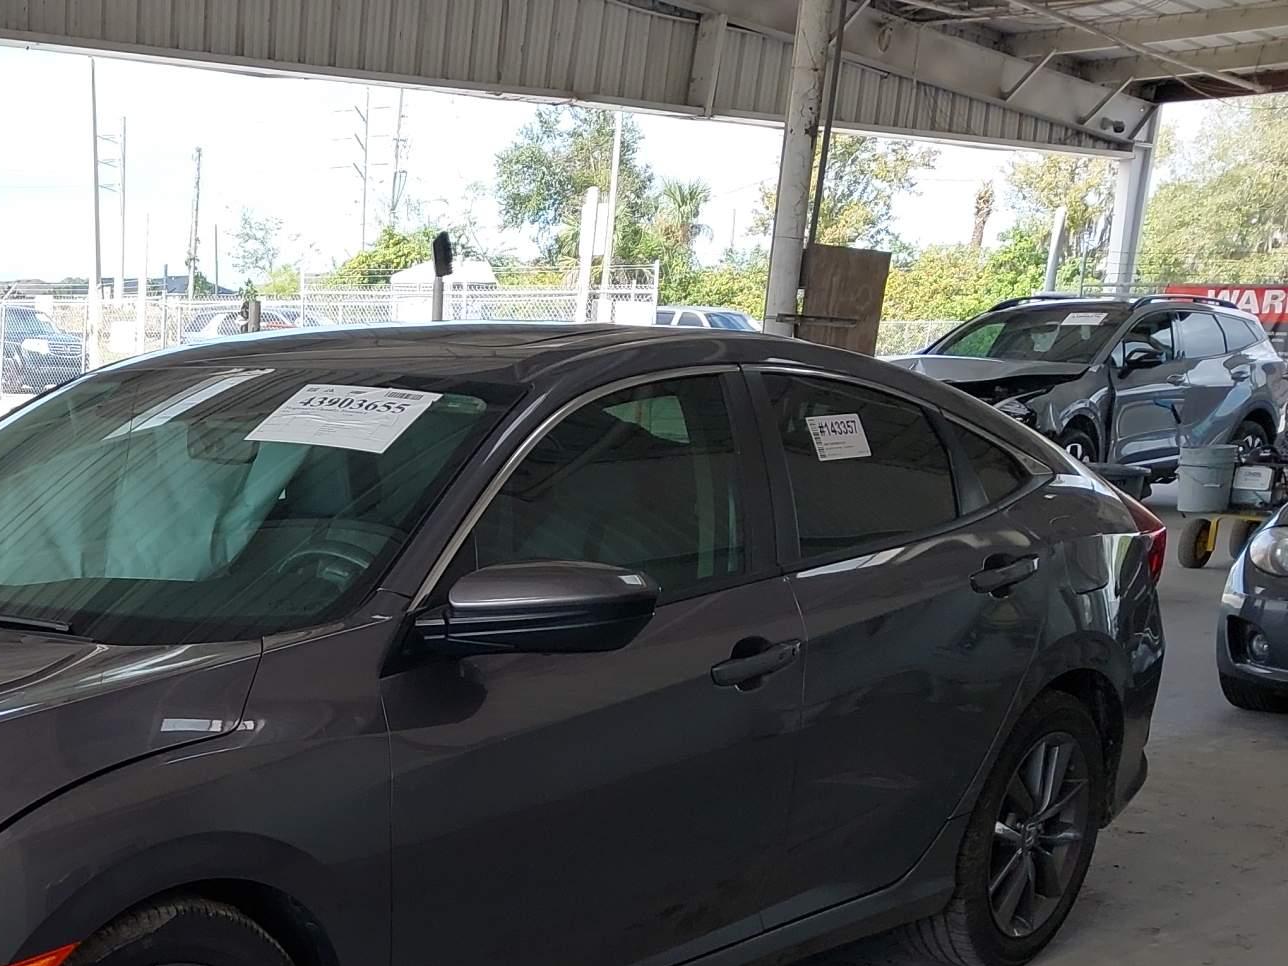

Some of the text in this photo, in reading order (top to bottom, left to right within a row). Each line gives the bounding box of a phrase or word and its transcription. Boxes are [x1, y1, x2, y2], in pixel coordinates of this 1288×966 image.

[1207, 289, 1288, 314] WAR
[299, 396, 411, 414] 43903655
[818, 420, 858, 436] #143357
